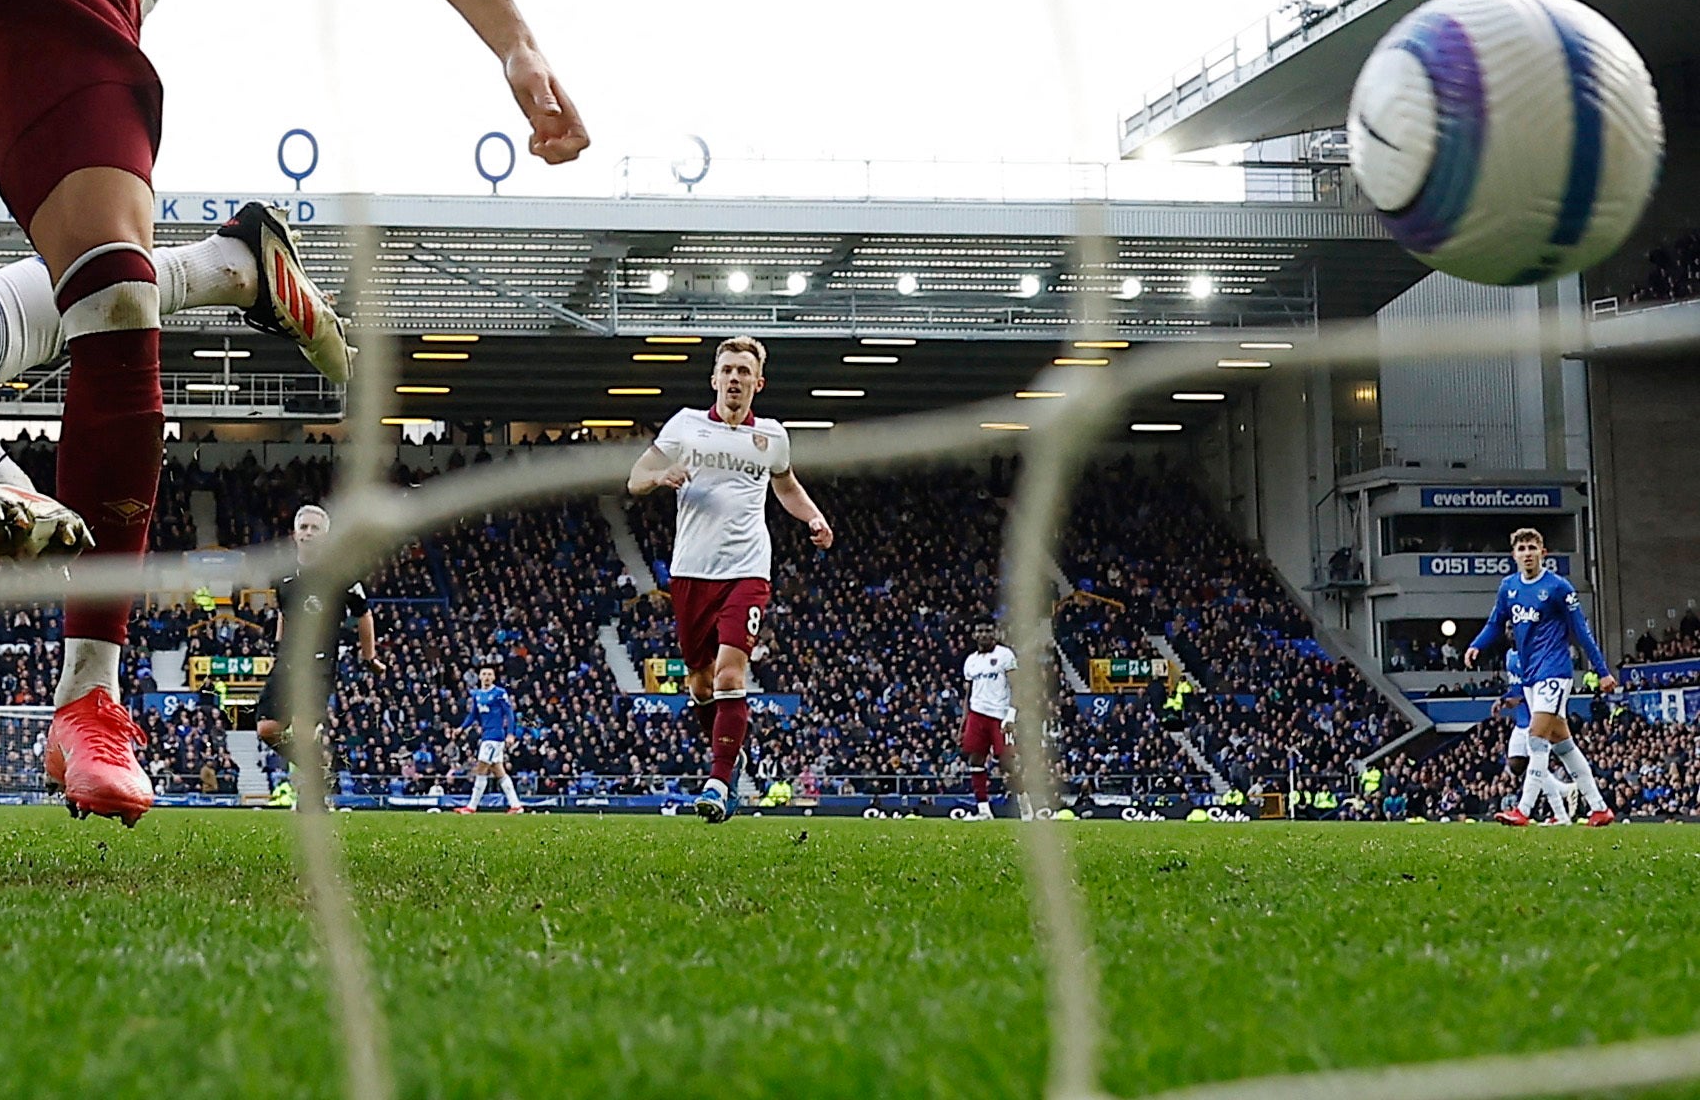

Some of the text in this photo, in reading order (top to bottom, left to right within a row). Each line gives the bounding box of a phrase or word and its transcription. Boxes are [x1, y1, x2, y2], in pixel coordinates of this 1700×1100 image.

[692, 449, 766, 481] betway
[1433, 490, 1549, 506] evertonfc.com
[1431, 558, 1469, 574] 0151
[1474, 558, 1511, 574] 556
[747, 606, 761, 636] 8
[1511, 604, 1540, 624] Stake
[1538, 680, 1560, 696] 29
